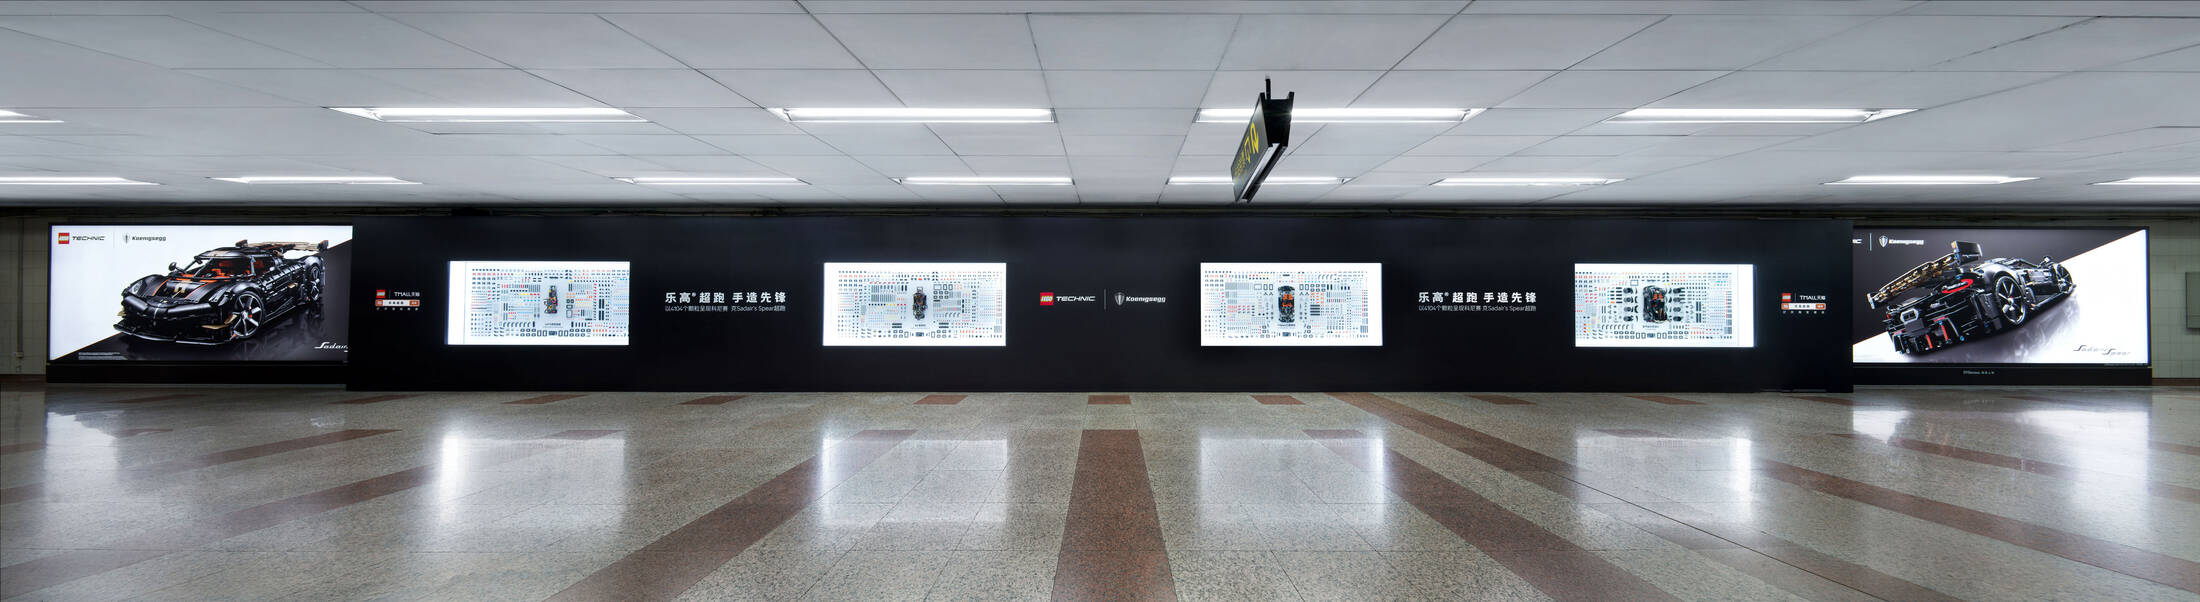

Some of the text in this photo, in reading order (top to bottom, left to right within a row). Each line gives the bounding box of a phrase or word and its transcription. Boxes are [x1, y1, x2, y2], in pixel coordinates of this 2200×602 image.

[732, 292, 786, 303] 手造先锋
[1483, 292, 1537, 303] 手造先锋
